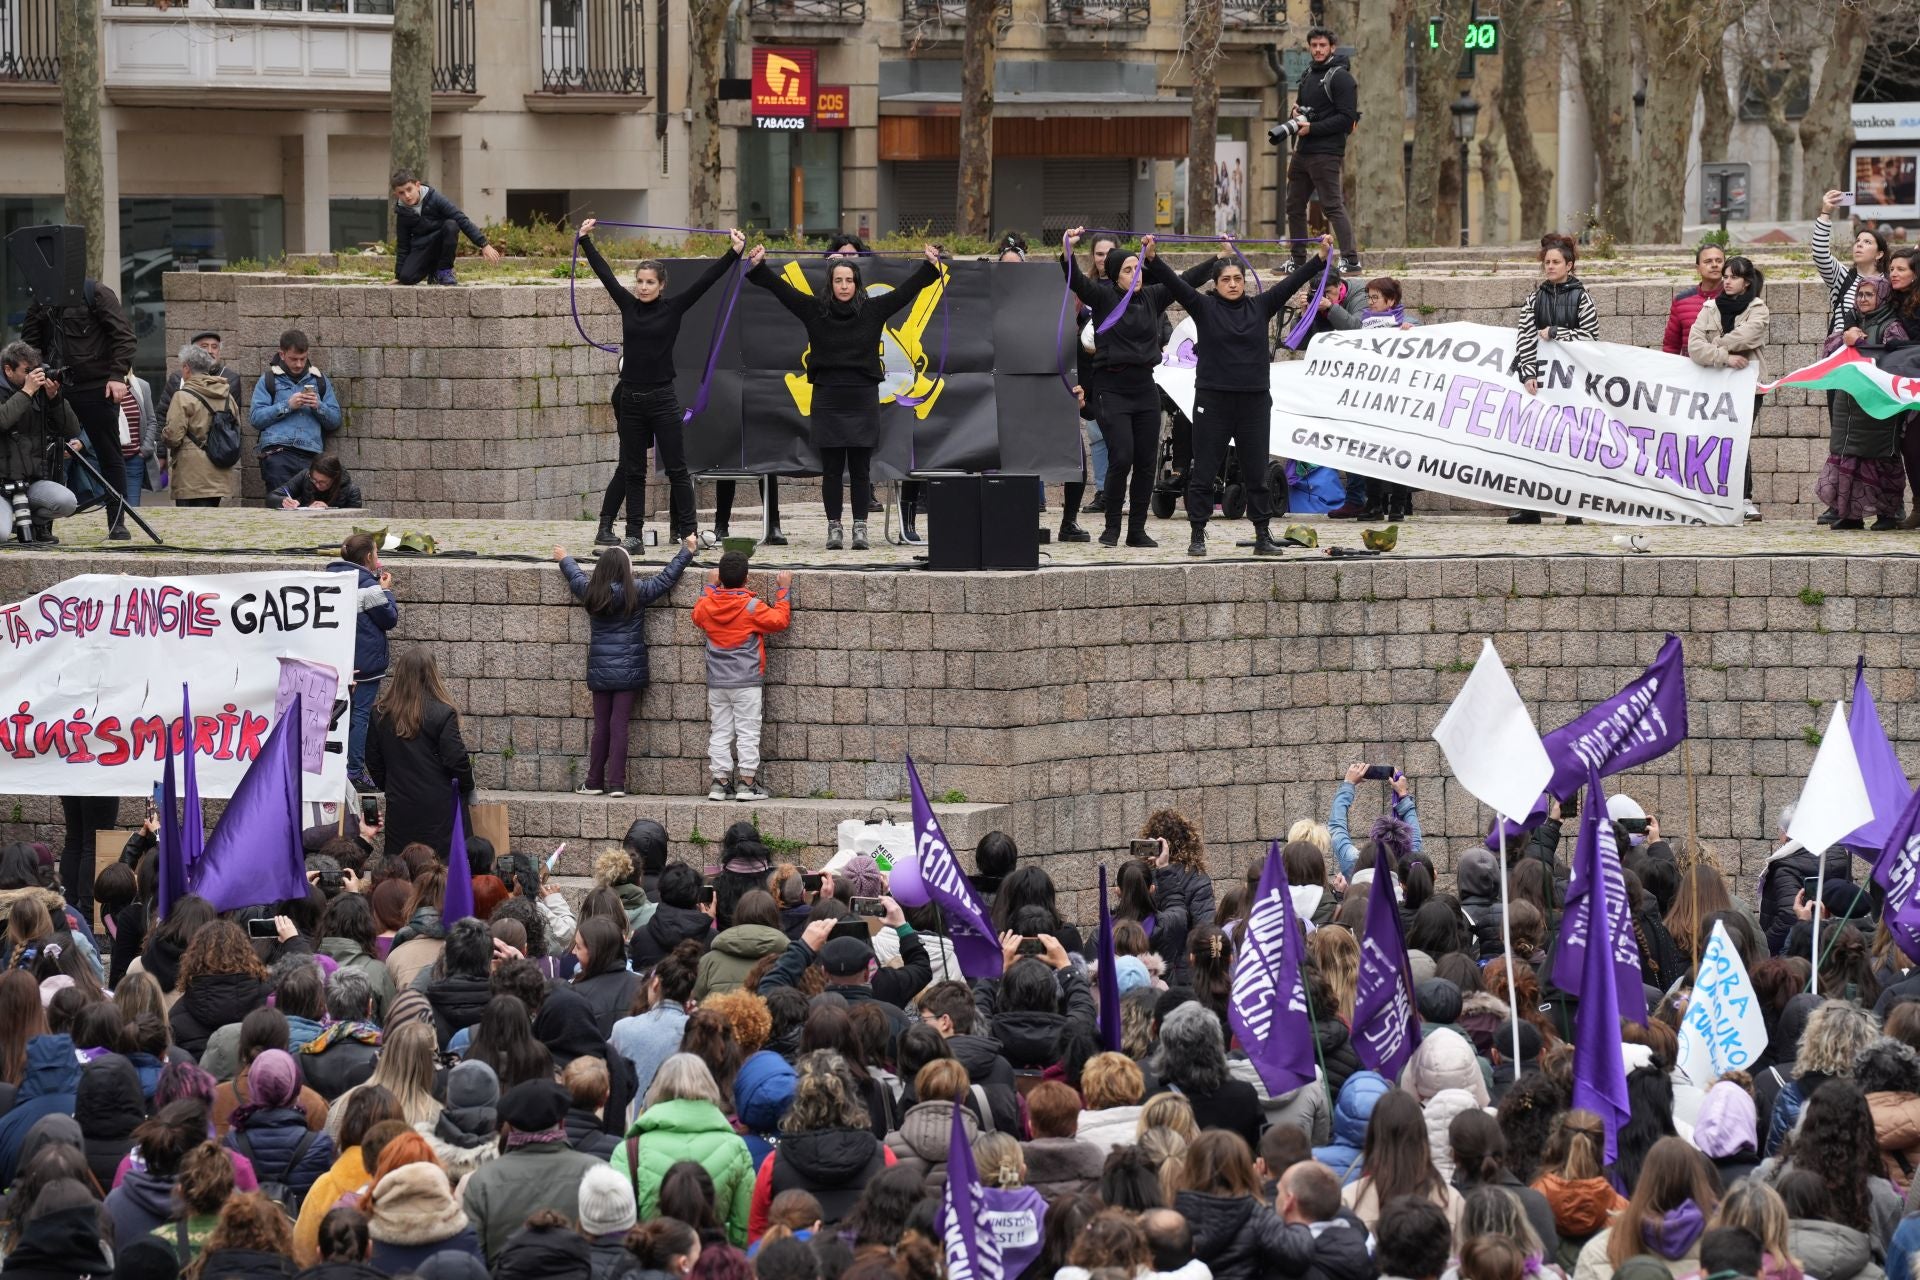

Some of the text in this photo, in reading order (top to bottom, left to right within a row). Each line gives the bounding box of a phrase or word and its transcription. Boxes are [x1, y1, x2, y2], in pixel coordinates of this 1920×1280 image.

[756, 117, 805, 129] TABACOS
[757, 95, 806, 105] TABACOS
[1305, 359, 1447, 392] AUSARDIA ETA
[1584, 370, 1739, 423] KONTRA
[1336, 388, 1436, 422] ALIANTZA
[1438, 373, 1734, 498] FEMINISTAK!
[1291, 427, 1413, 470] GASTEIZKO
[1417, 454, 1572, 506] MUGIMENDU
[0, 584, 342, 650] TA SEXU LANGILE GABE
[1703, 936, 1750, 1018] GORA
